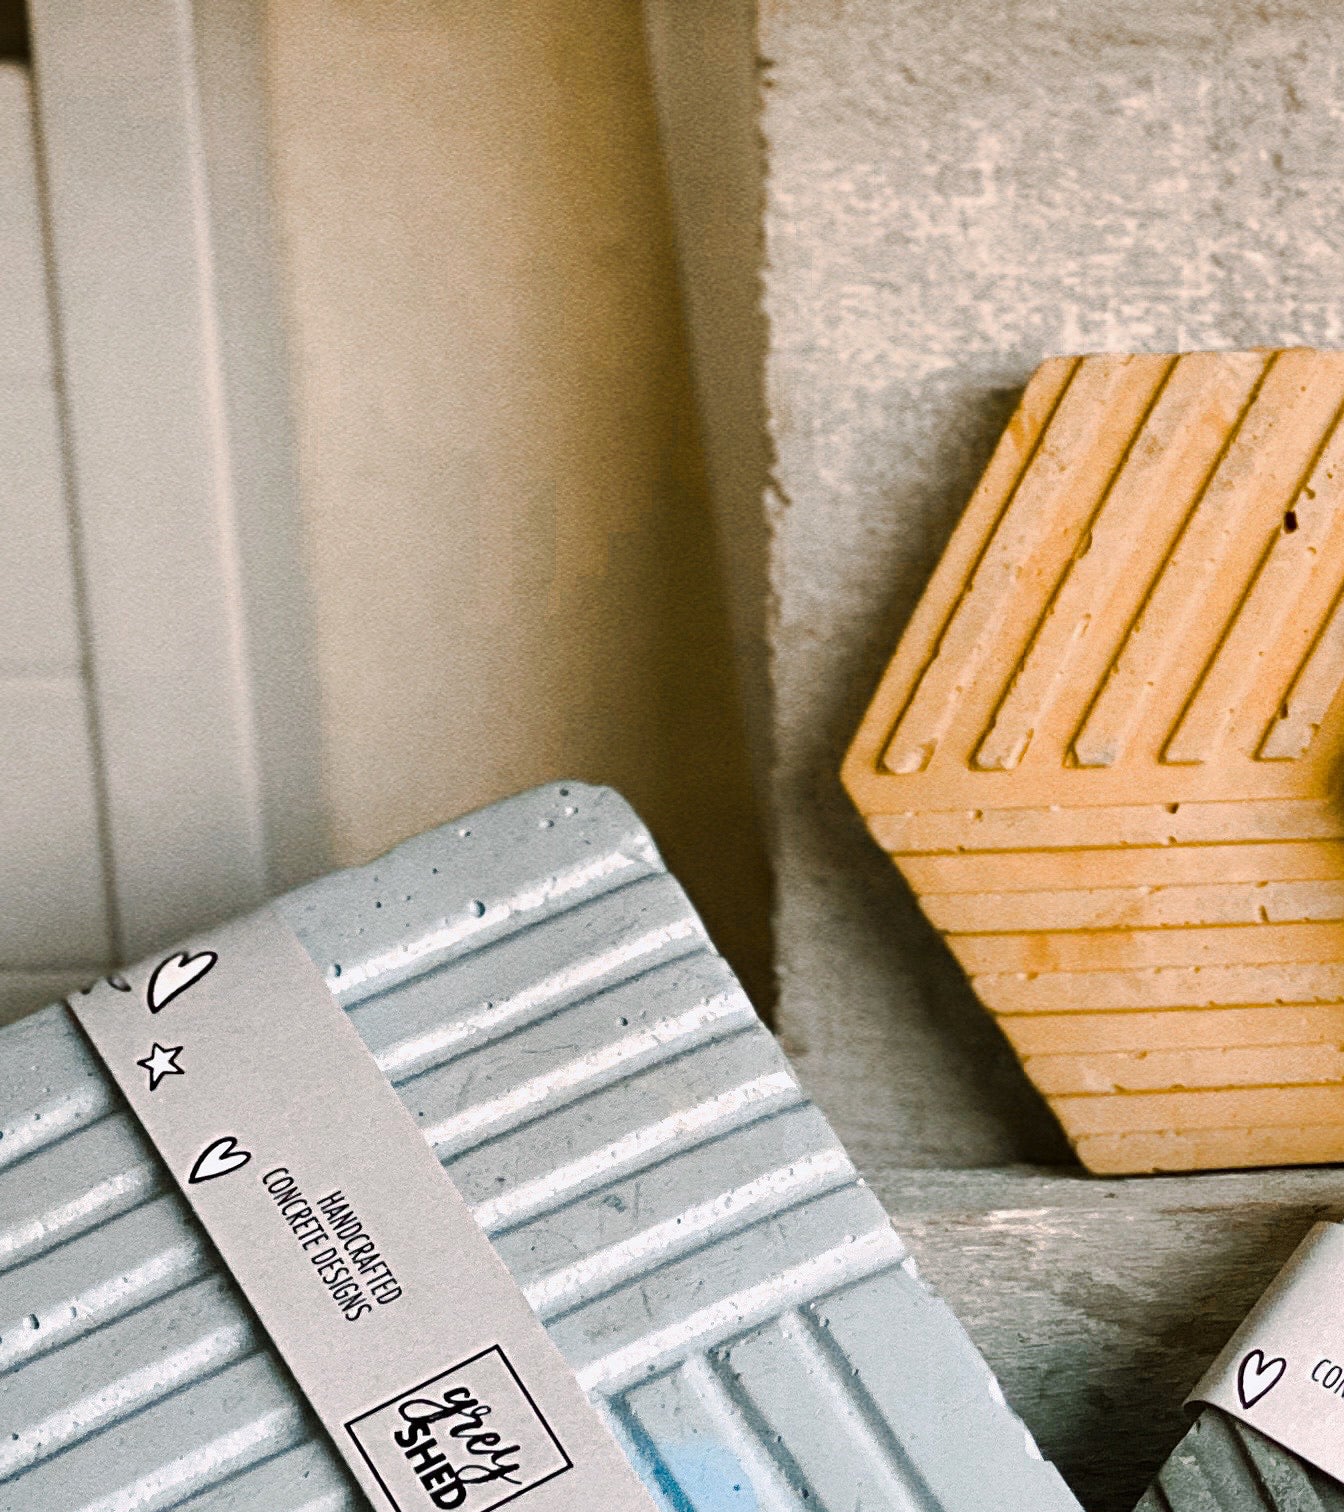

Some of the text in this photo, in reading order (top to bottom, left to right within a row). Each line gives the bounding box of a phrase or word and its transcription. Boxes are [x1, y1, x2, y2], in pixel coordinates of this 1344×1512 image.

[262, 1167, 372, 1322] CONCRETE DESIGNS
[317, 1190, 402, 1305] HANDCRAFTED
[394, 1421, 467, 1510] SHED
[398, 1387, 522, 1485] grey
